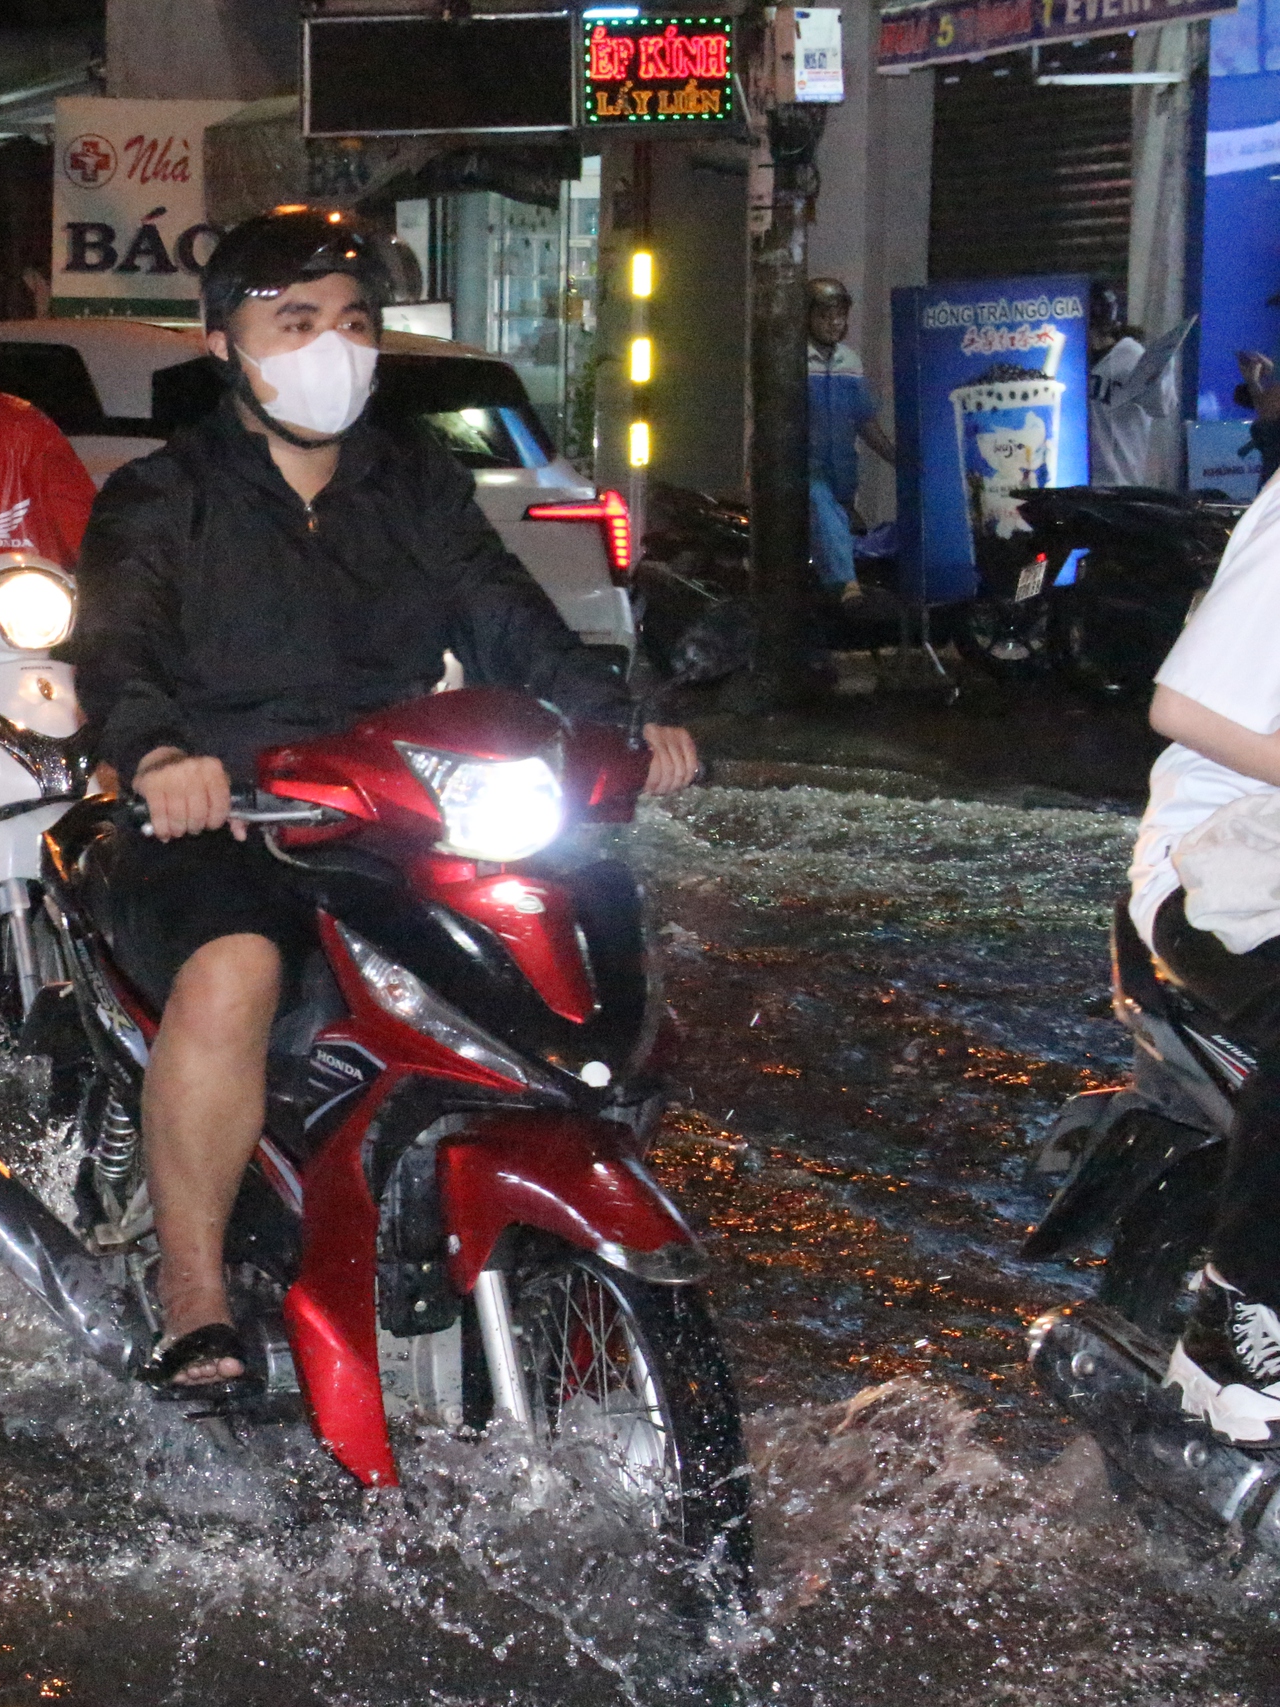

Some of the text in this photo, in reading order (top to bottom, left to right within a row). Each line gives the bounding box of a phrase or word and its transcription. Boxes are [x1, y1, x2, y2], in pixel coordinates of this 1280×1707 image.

[936, 14, 955, 47] 5
[638, 25, 727, 78] KÍNH
[124, 134, 191, 185] Nhà
[977, 298, 1010, 323] TRÀ
[1013, 295, 1049, 320] NGÔ
[1053, 297, 1083, 318] GIA
[316, 1049, 365, 1081] HONDA
